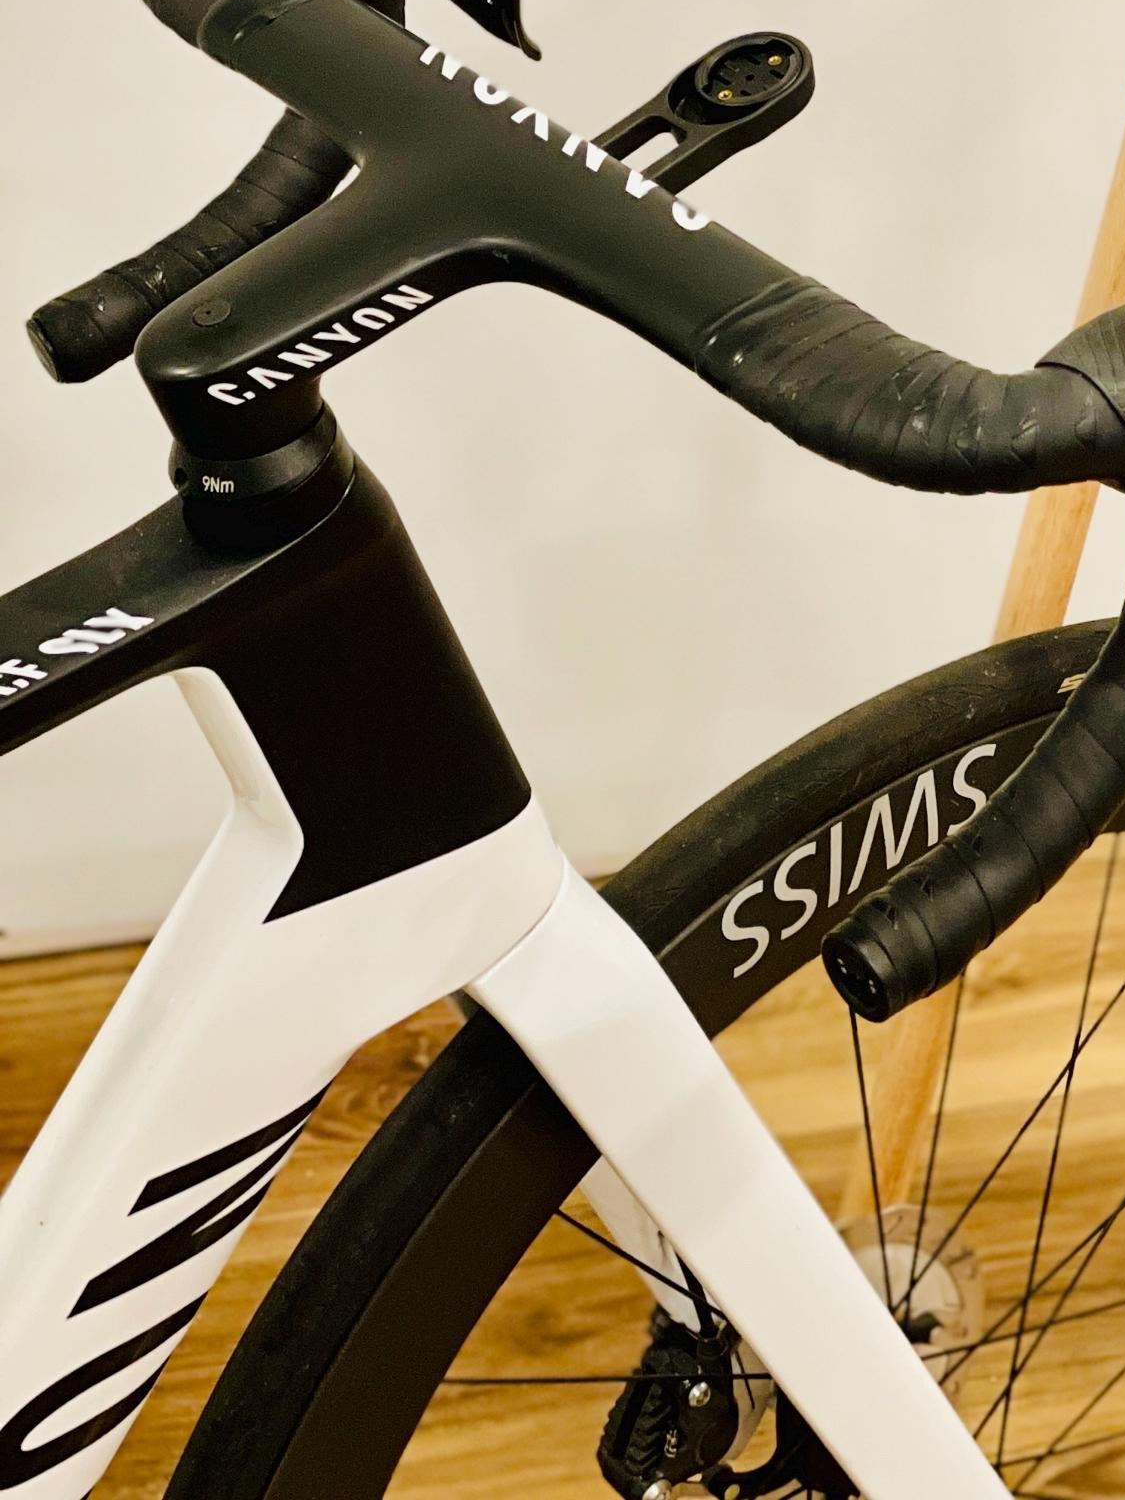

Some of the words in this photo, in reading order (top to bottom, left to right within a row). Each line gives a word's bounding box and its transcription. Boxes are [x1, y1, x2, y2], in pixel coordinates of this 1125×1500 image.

[207, 284, 434, 406] CANYON
[201, 475, 235, 494] 9Nm
[720, 743, 997, 979] SWISS
